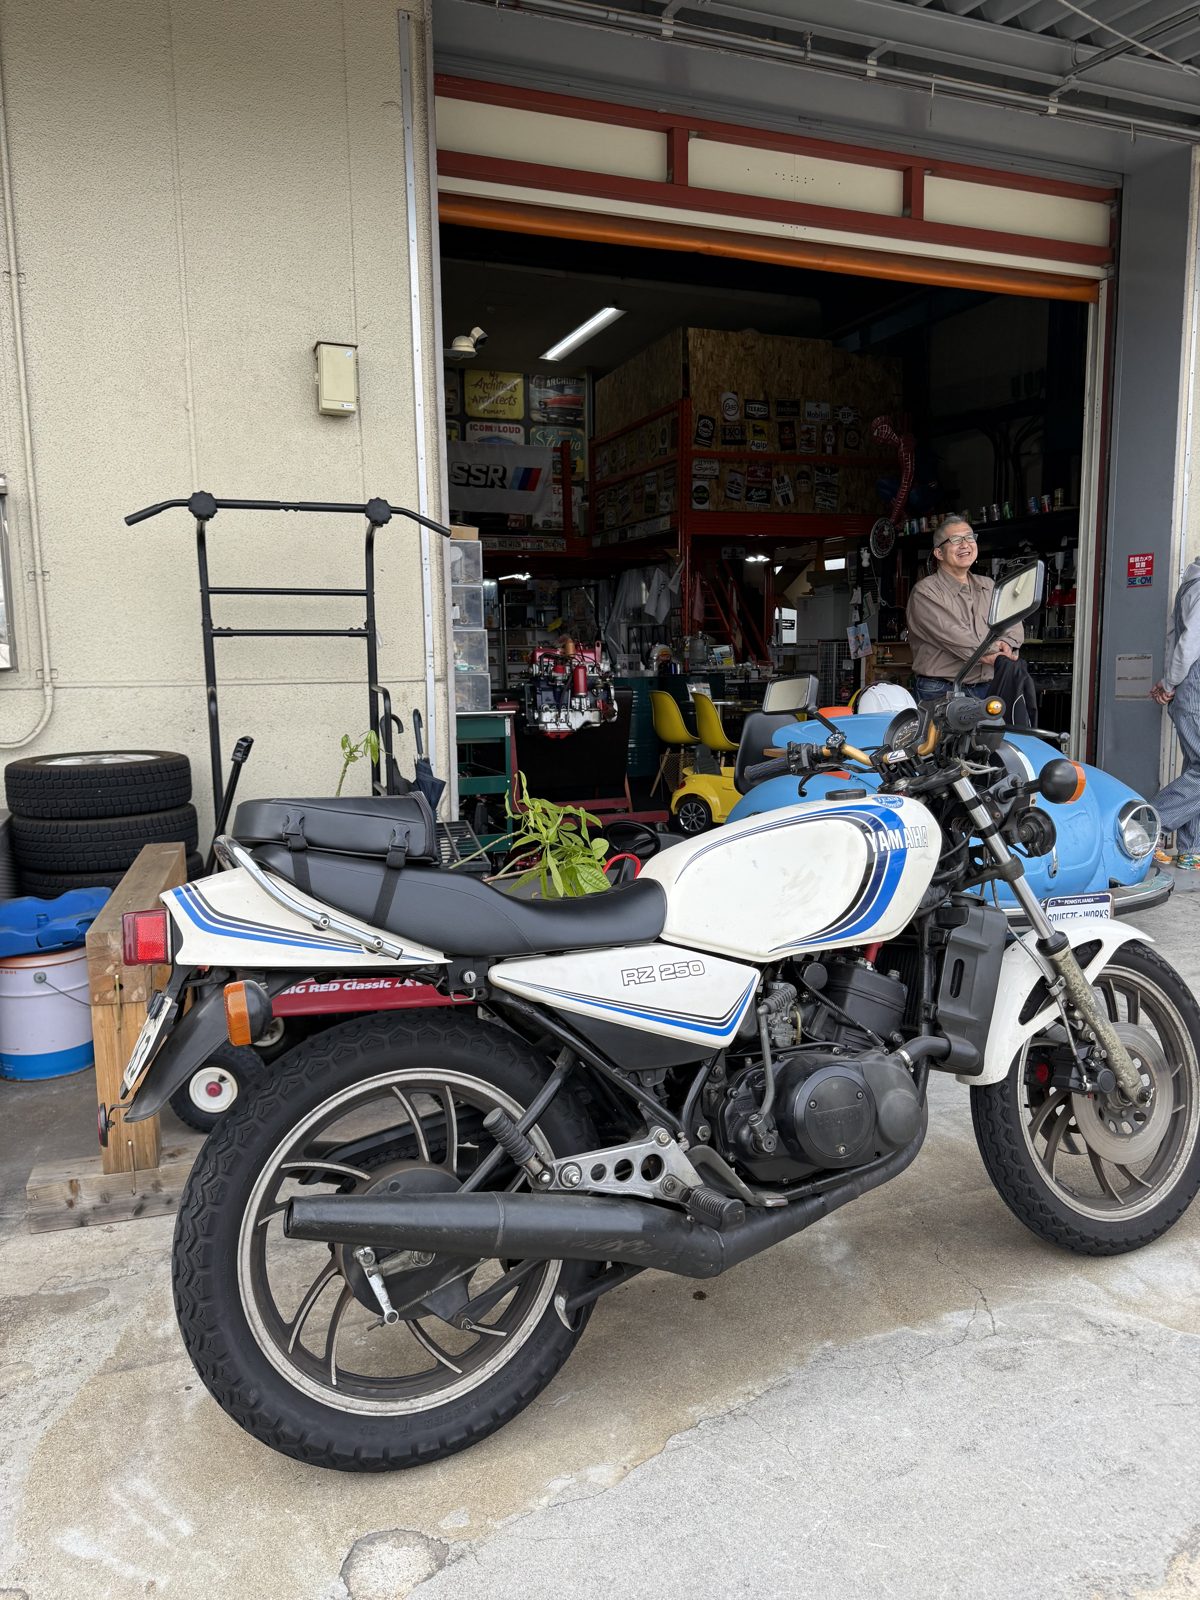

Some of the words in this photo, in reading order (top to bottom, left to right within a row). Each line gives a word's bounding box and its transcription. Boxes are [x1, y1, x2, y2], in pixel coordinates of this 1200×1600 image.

[448, 461, 507, 489] SSR
[1128, 576, 1152, 585] SECOM
[865, 825, 928, 853] YAMAHA
[308, 981, 341, 993] RED
[342, 978, 392, 991] Classic
[621, 965, 656, 986] RZ
[659, 959, 705, 981] 250
